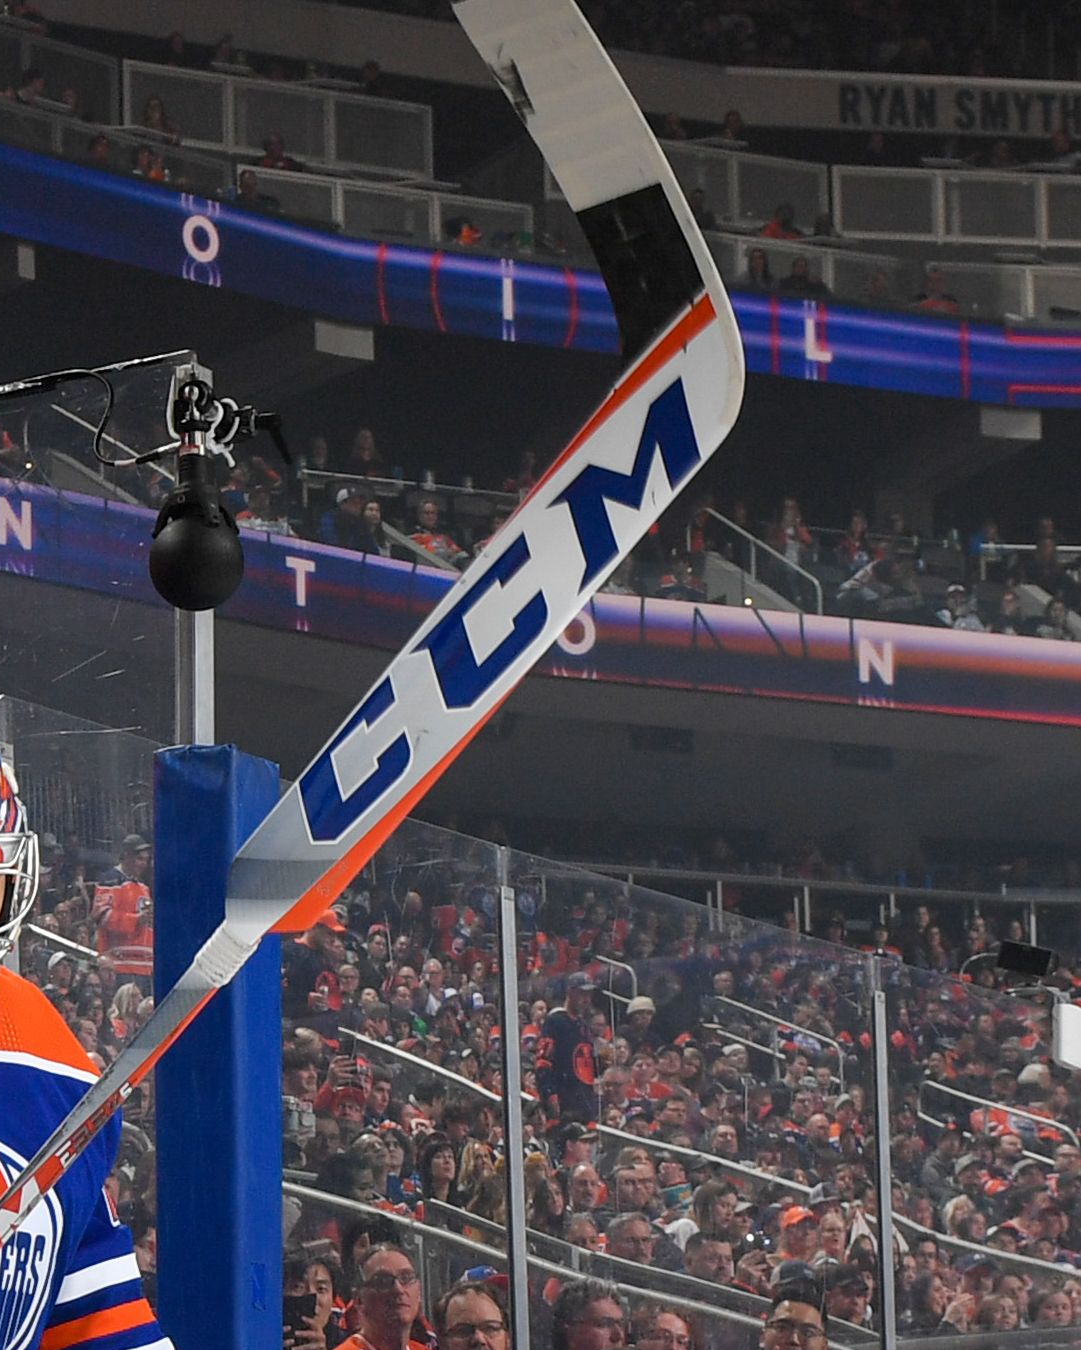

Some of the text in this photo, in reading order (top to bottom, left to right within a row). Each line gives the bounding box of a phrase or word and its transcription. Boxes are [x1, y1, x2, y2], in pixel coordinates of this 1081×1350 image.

[839, 82, 1081, 140] RYAN SMYTH
[298, 376, 702, 845] CCM
